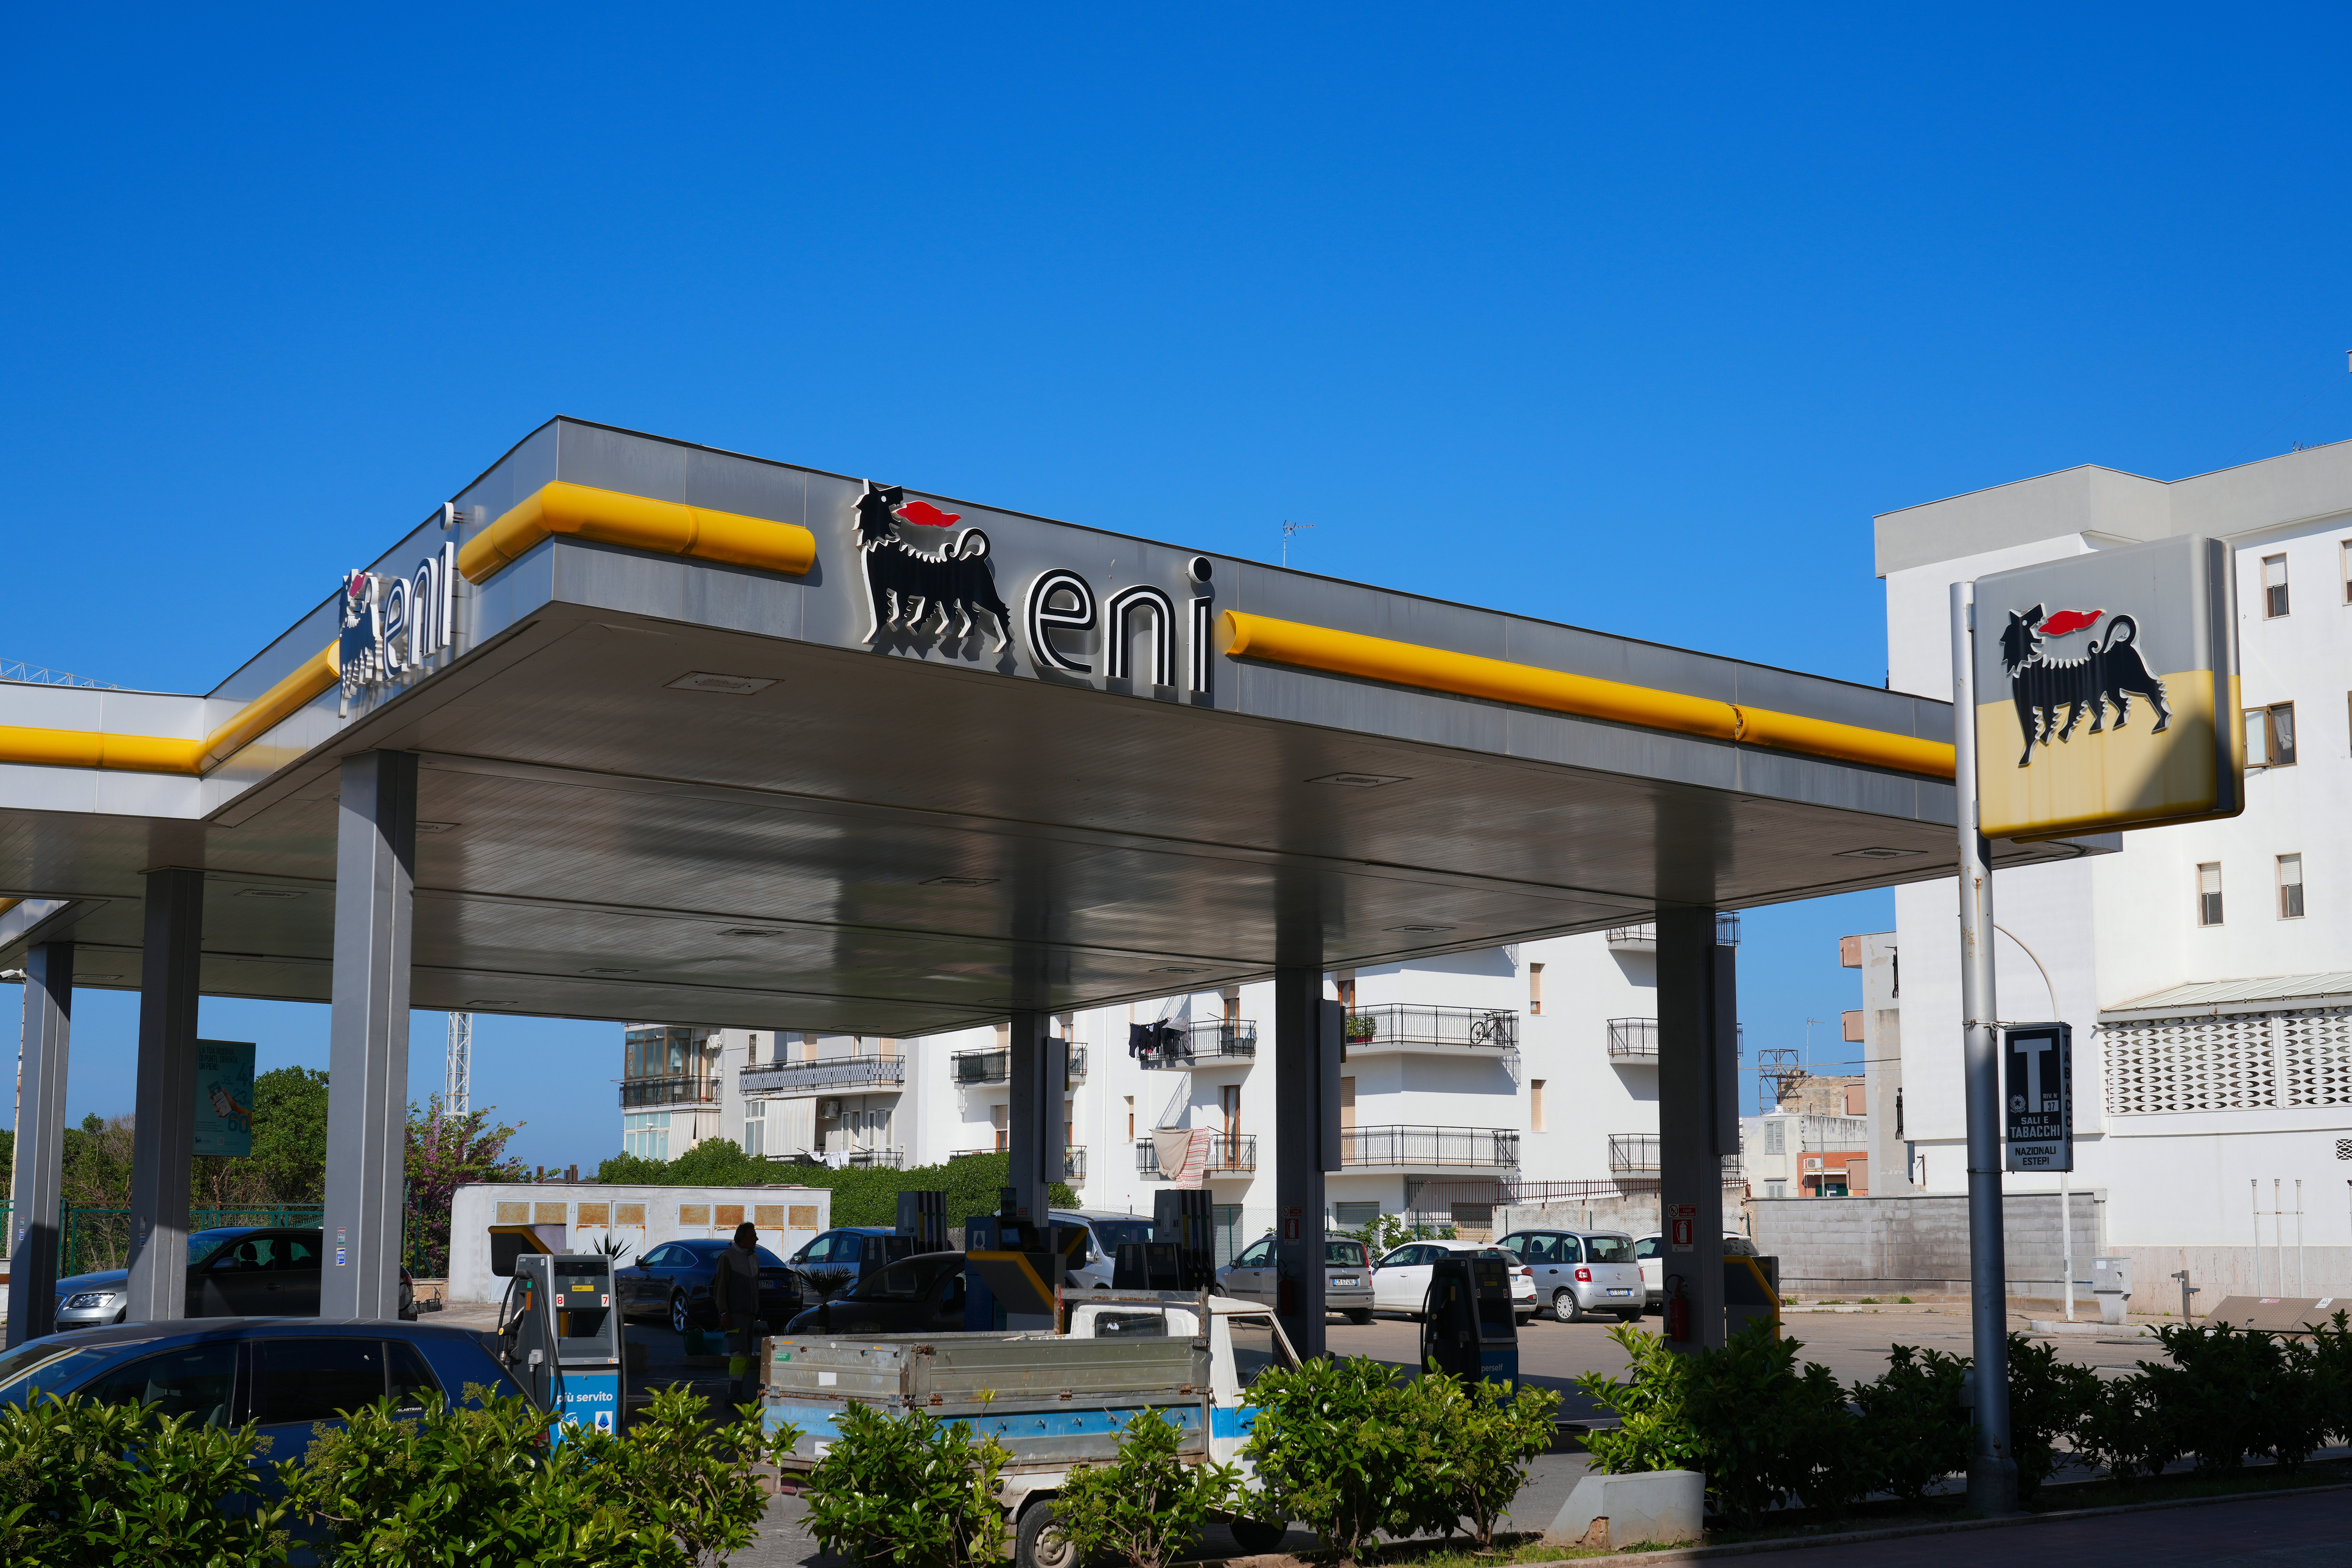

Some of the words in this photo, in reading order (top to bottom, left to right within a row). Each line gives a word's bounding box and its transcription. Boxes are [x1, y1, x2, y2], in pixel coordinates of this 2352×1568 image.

[383, 502, 455, 682] eni
[1023, 556, 1213, 693] eni
[206, 1046, 215, 1055] TUA
[216, 1047, 234, 1056] RISERVA
[220, 1055, 238, 1064] DIVENTA
[221, 1074, 231, 1085] 35
[2014, 1037, 2052, 1113] T
[232, 1088, 247, 1105] 23
[2063, 1034, 2072, 1160] TABACCHI
[2048, 1102, 2055, 1111] 37
[228, 1111, 249, 1134] 60
[2021, 1116, 2040, 1125] SALI
[2010, 1125, 2060, 1138] TABACCHI
[2015, 1146, 2056, 1155] NAZIONALI
[556, 1391, 574, 1405] più
[576, 1390, 614, 1402] servito
